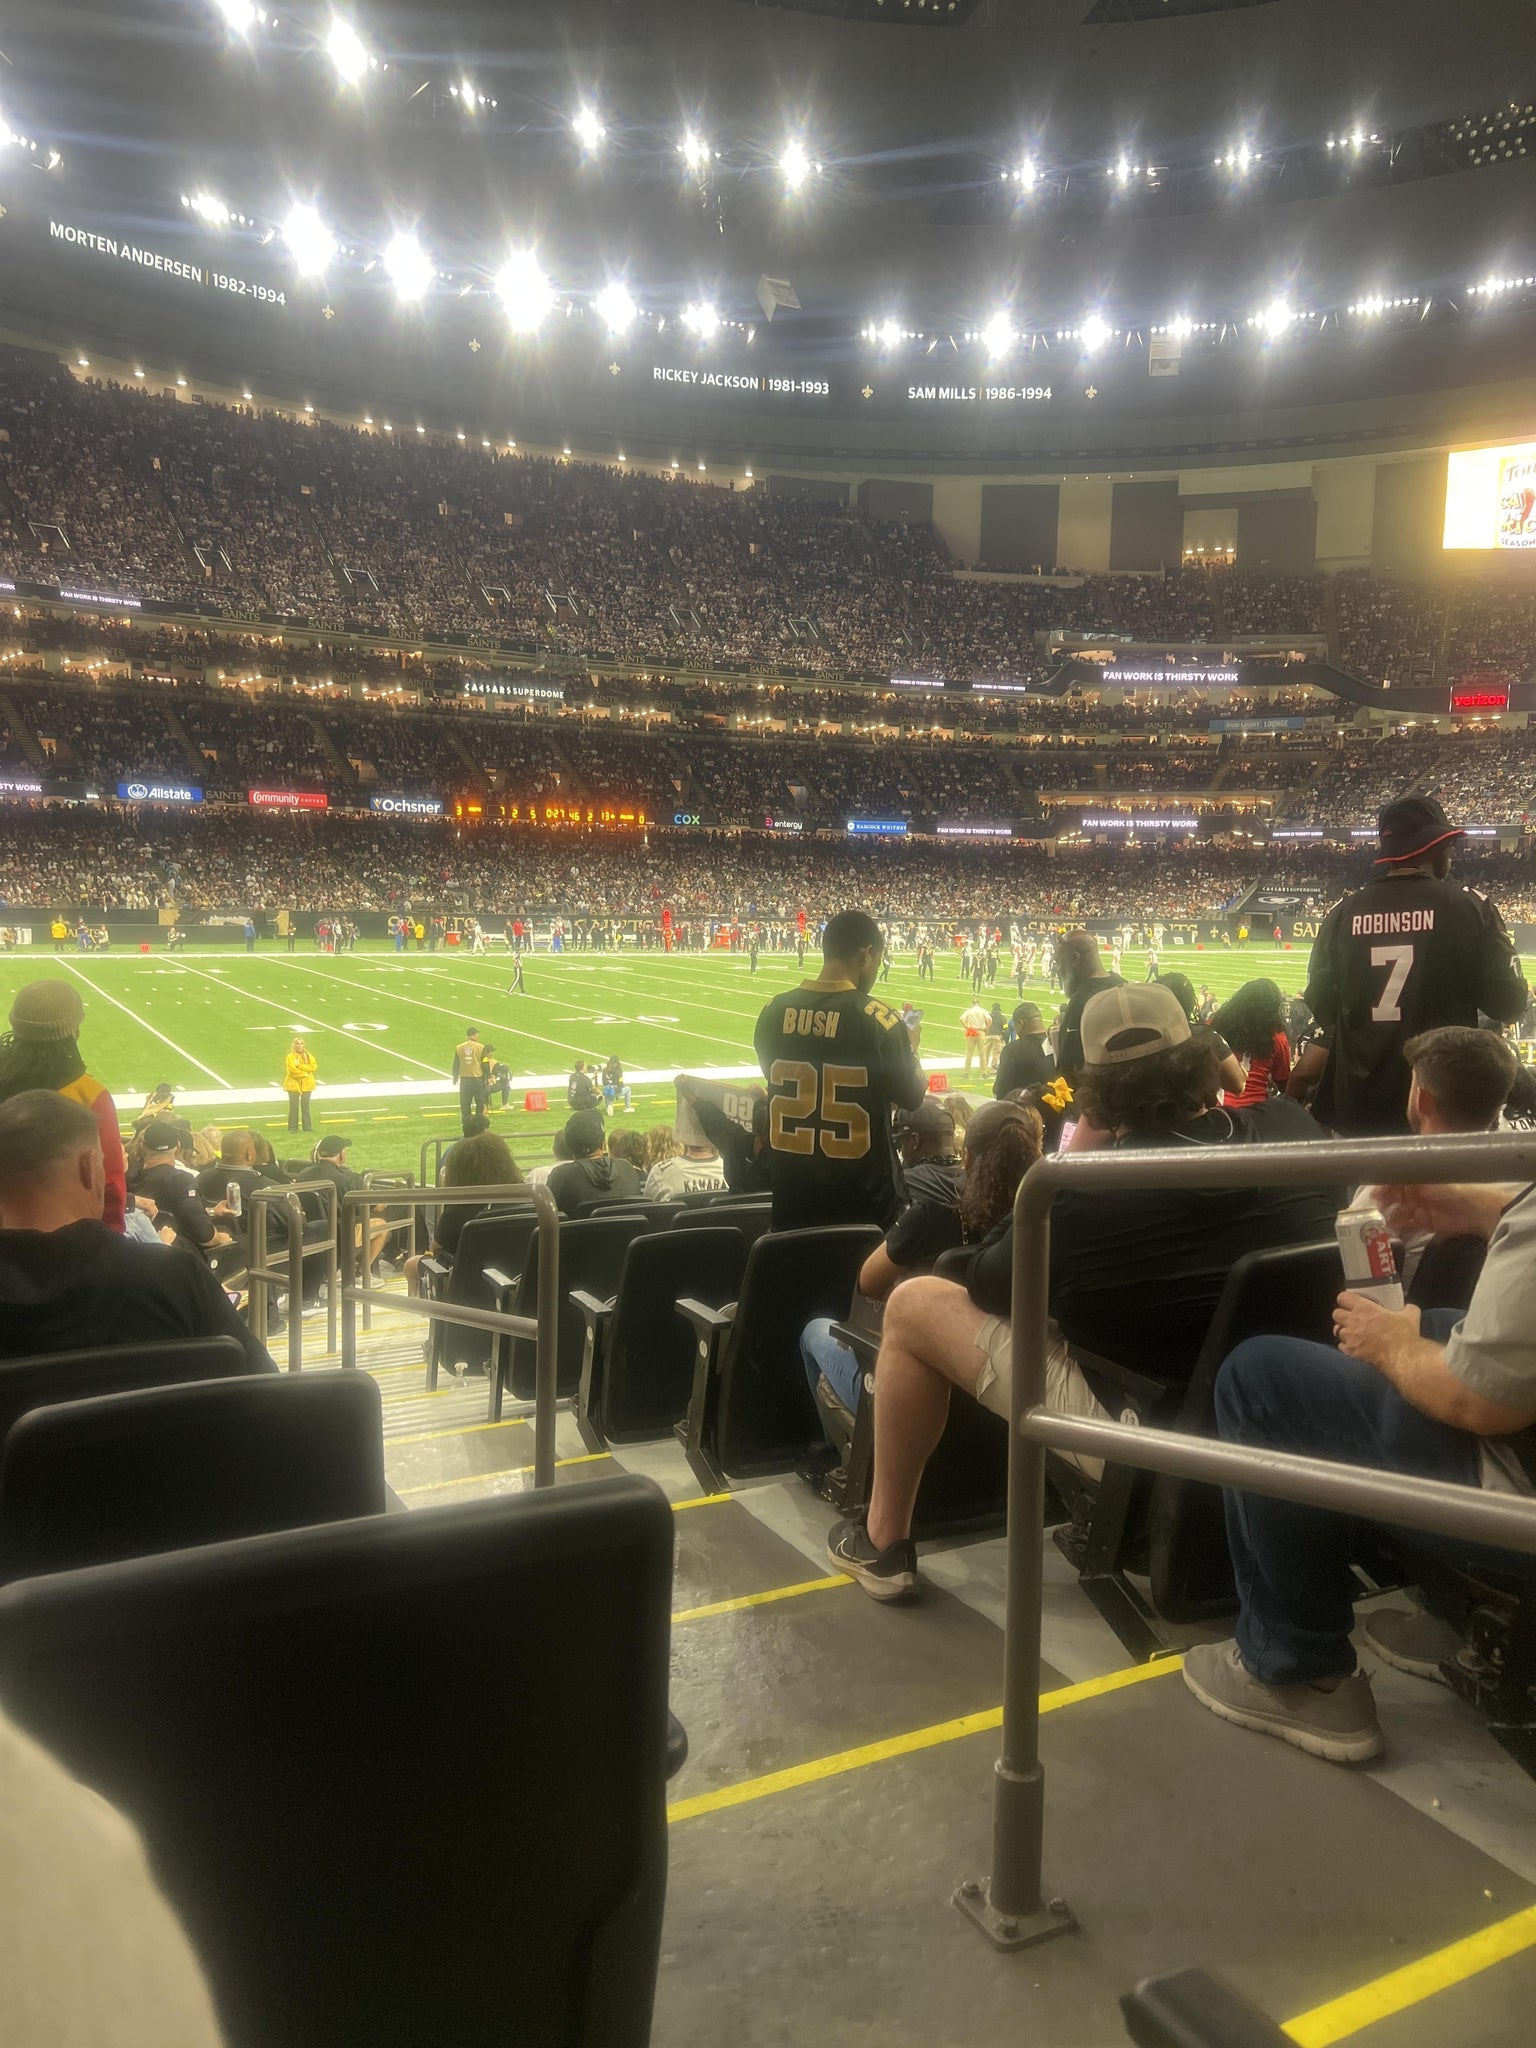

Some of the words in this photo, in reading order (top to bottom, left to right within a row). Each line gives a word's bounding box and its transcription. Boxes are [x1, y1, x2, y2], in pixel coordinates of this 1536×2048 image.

[50, 221, 118, 256] MORTEN
[120, 245, 202, 282] ANDERSEN
[212, 273, 287, 306] 1982-1994
[653, 367, 699, 384] RICKEY
[700, 373, 759, 390] JACKSON
[768, 378, 830, 395] 1981-1993
[908, 386, 936, 399] SAM
[938, 387, 976, 400] MILLS
[985, 387, 1053, 400] 1986-1994
[60, 590, 73, 598] FAN
[73, 593, 92, 601] WORK
[98, 596, 123, 605] THIRSTY
[222, 609, 261, 622] SAINTS
[308, 620, 345, 632] SAINTS
[388, 629, 424, 641] SAINTS
[467, 637, 501, 649] SAINTS
[614, 653, 646, 664] SAINTS
[683, 660, 714, 670] SAINTS
[750, 665, 779, 676] SAINTS
[1103, 671, 1123, 680] FAN
[1123, 671, 1153, 681] WORK
[1154, 672, 1164, 681] IS
[1165, 672, 1206, 682] THIRSTY
[1207, 673, 1239, 682] WORK
[512, 687, 565, 699] SUPERDOME
[1453, 693, 1507, 706] verizon
[1079, 722, 1109, 730] SAINTS
[1144, 722, 1174, 730] SAINTS
[1264, 719, 1288, 728] LOUNGE
[15, 784, 42, 792] WORK
[149, 787, 192, 800] Allstate
[205, 789, 244, 801] SAINTS
[253, 791, 300, 806] Community
[382, 799, 441, 814] Ochsner
[456, 805, 463, 816] 3
[511, 808, 519, 819] 2
[530, 809, 537, 819] 5
[545, 808, 565, 818] 0:27
[569, 812, 580, 821] 46
[587, 812, 593, 822] 2
[674, 813, 701, 826] COX
[720, 816, 750, 826] SAINTS
[774, 820, 803, 830] entergy
[1082, 819, 1099, 827] FAN
[1099, 820, 1125, 828] WORK
[1126, 820, 1135, 828] IS
[1135, 820, 1171, 828] THIRSTY
[1172, 820, 1199, 828] WORK
[995, 828, 1013, 836] WORK
[1352, 910, 1435, 935] ROBINSON
[1370, 944, 1414, 1022] 7
[782, 1007, 840, 1038] BUSH
[769, 1058, 871, 1160] 25
